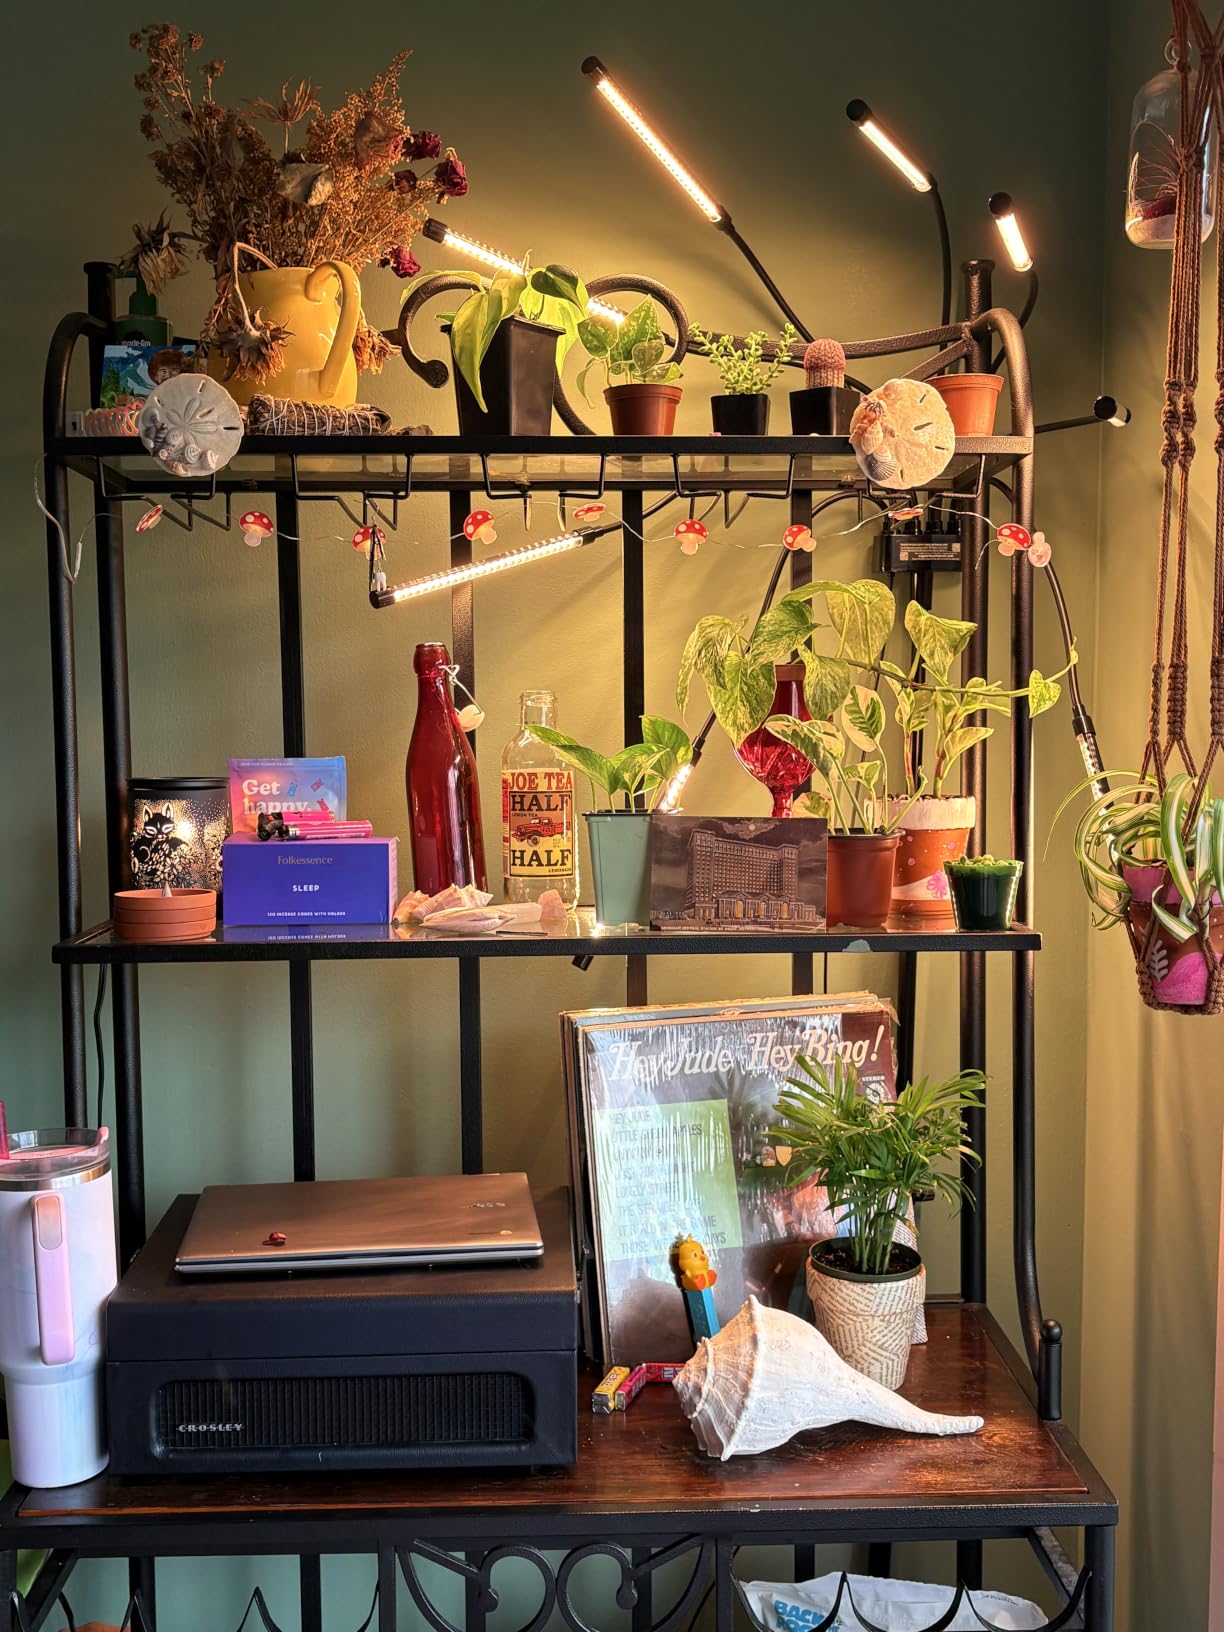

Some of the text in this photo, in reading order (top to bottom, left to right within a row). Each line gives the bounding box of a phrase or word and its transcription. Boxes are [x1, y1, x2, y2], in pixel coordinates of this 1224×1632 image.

[242, 779, 281, 796] Get
[508, 772, 573, 791] JOE TEA
[510, 794, 572, 812] HALF
[277, 855, 333, 865] Folkessence
[511, 849, 573, 868] HALF
[292, 884, 320, 892] SLEEP
[668, 1035, 731, 1076] Jude
[747, 1031, 801, 1072] Hey
[802, 1024, 885, 1068] Bing!
[177, 1423, 243, 1433] CROSLEY
